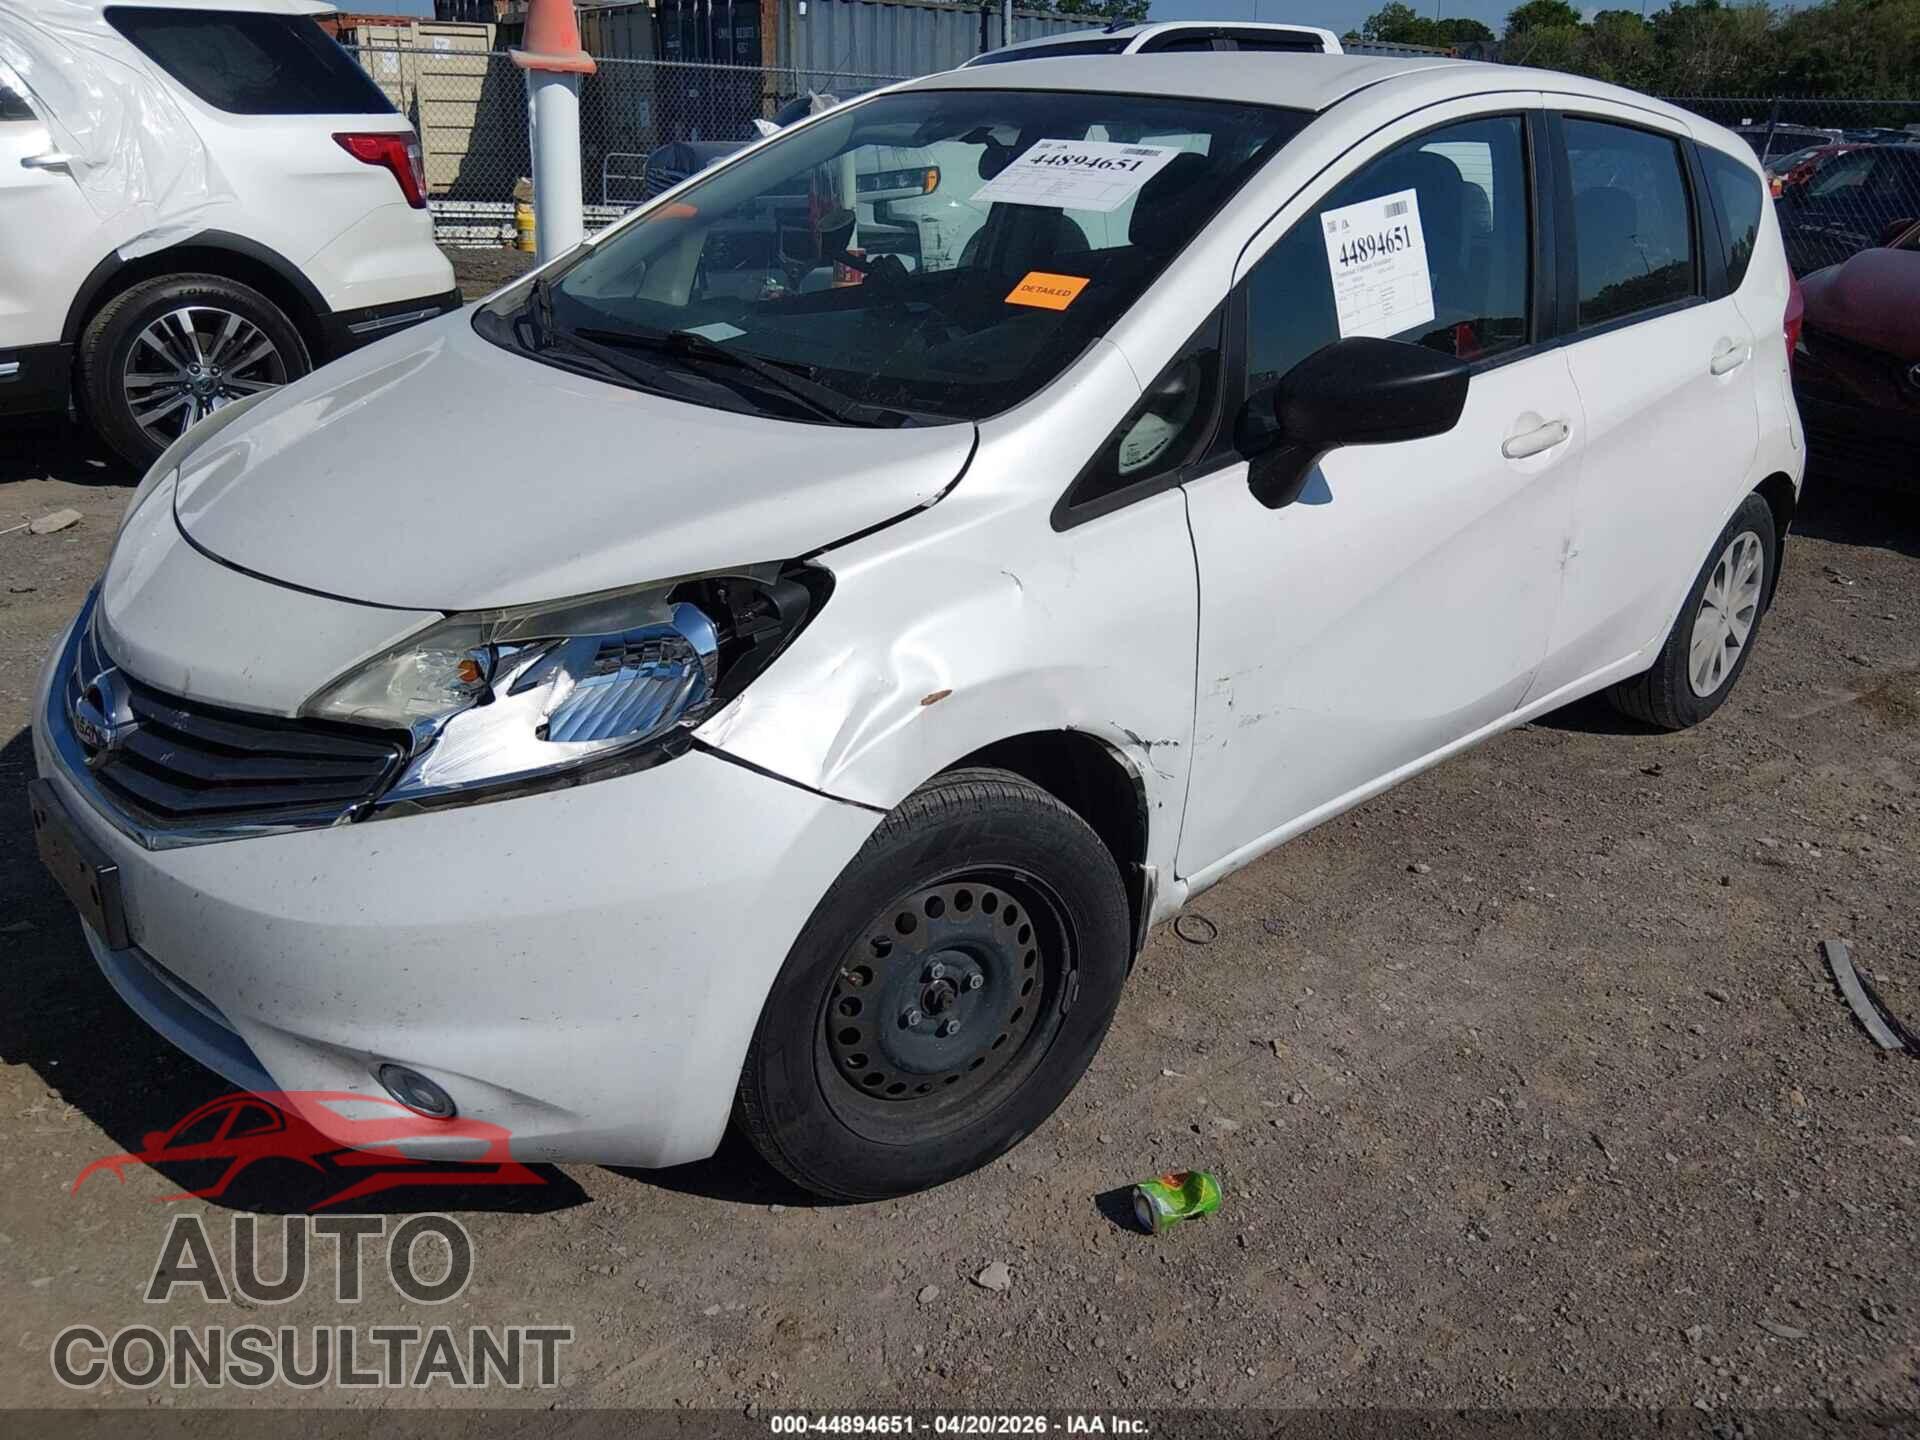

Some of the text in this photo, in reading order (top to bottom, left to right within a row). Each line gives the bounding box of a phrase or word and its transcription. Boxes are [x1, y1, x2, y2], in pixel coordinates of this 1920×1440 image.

[1030, 153, 1143, 172] 44894651
[1340, 224, 1412, 267] 44894651
[1021, 284, 1071, 298] DETAILED
